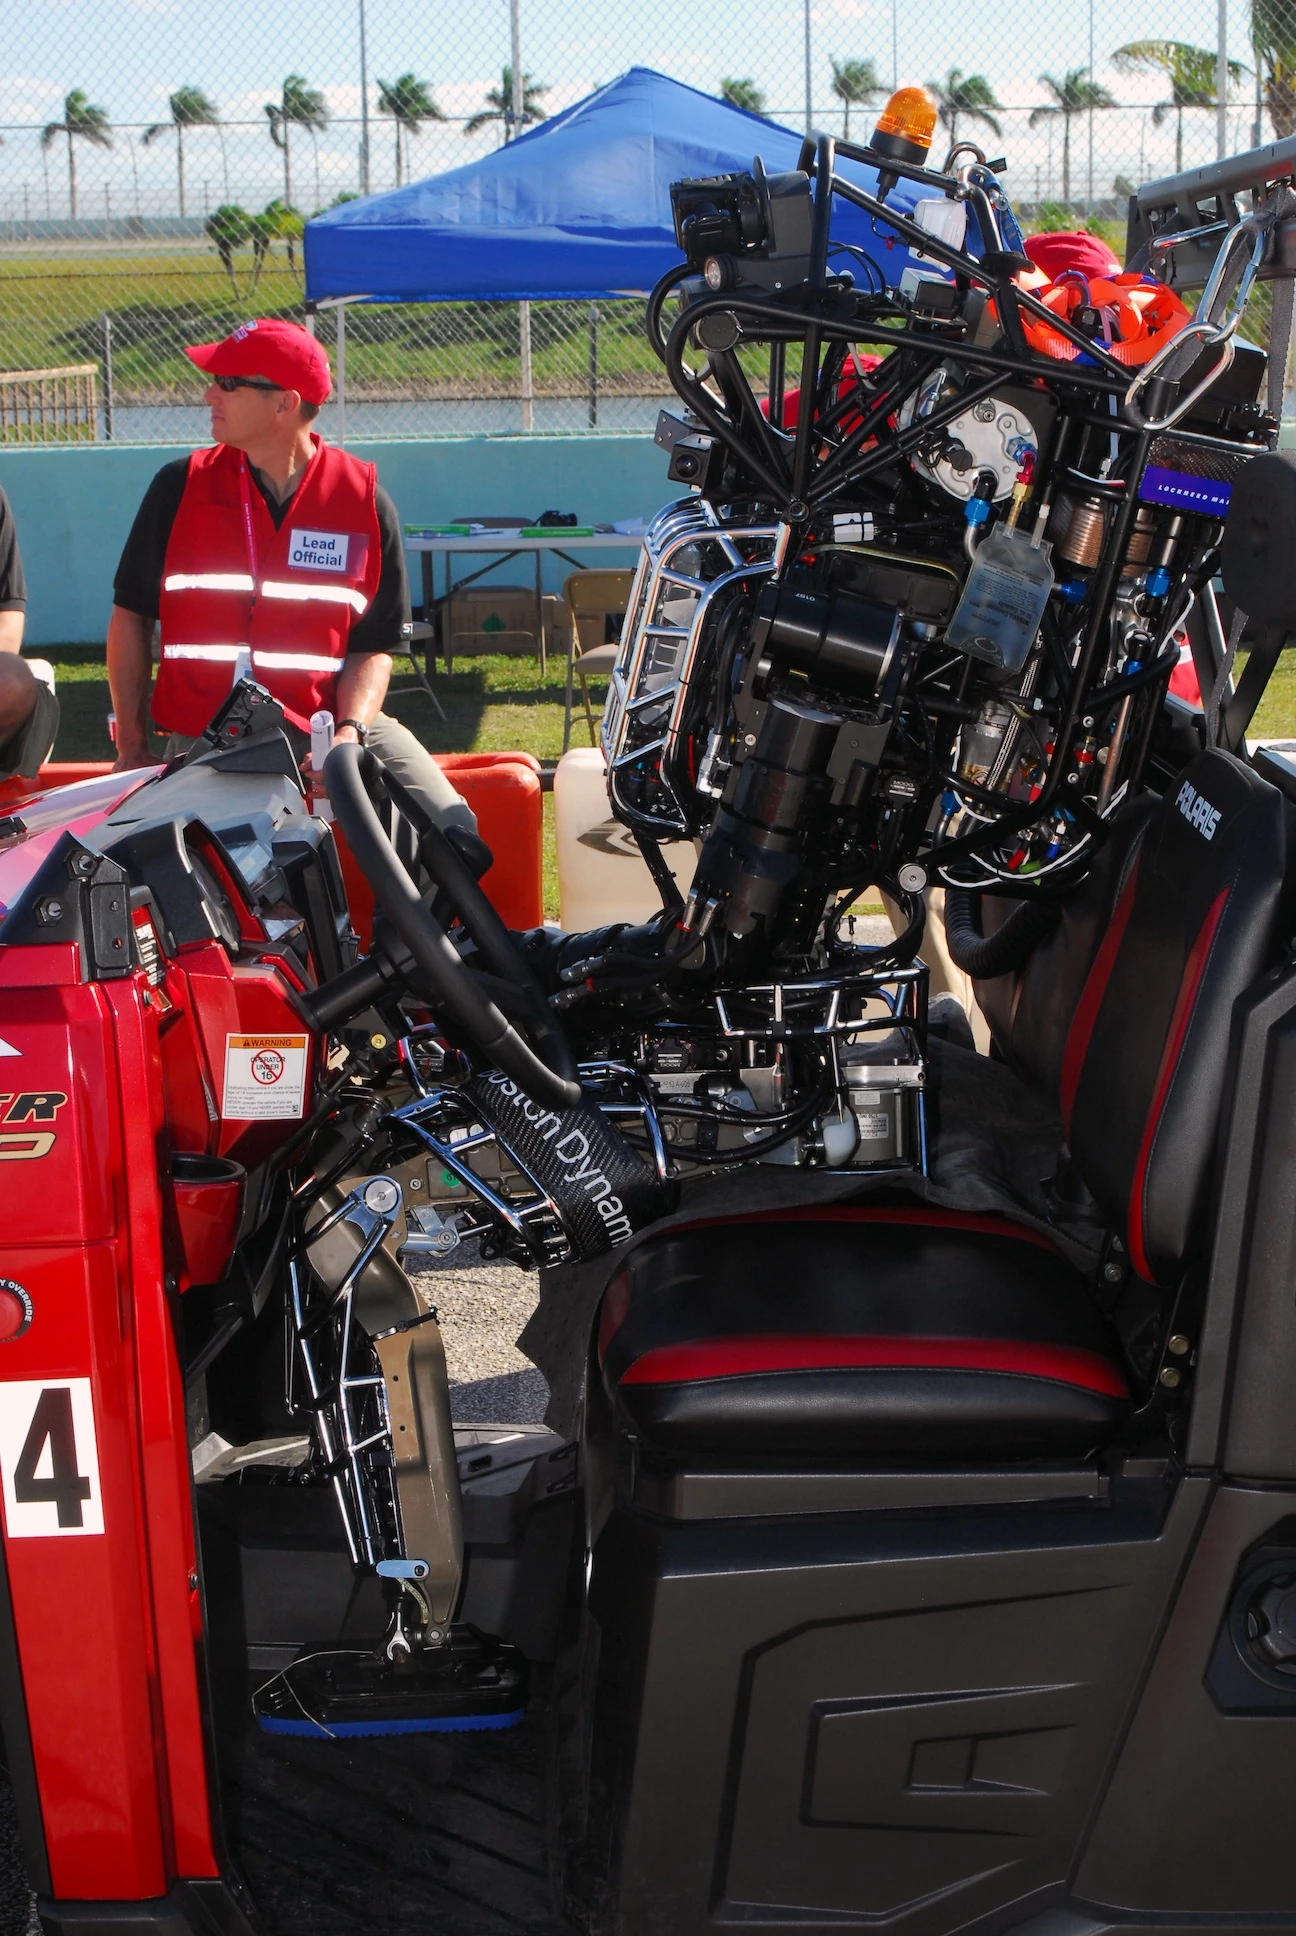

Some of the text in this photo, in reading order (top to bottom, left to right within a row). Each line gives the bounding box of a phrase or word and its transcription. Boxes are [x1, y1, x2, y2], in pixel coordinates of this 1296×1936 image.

[1158, 484, 1208, 500] LOCKHEED
[302, 536, 336, 550] Lead
[293, 550, 342, 566] Official
[1175, 780, 1222, 840] POLARIS
[252, 1039, 292, 1047] WARNING
[262, 1071, 272, 1080] 16
[8, 1281, 33, 1322] OVERRIDE
[14, 1388, 92, 1528] 4
